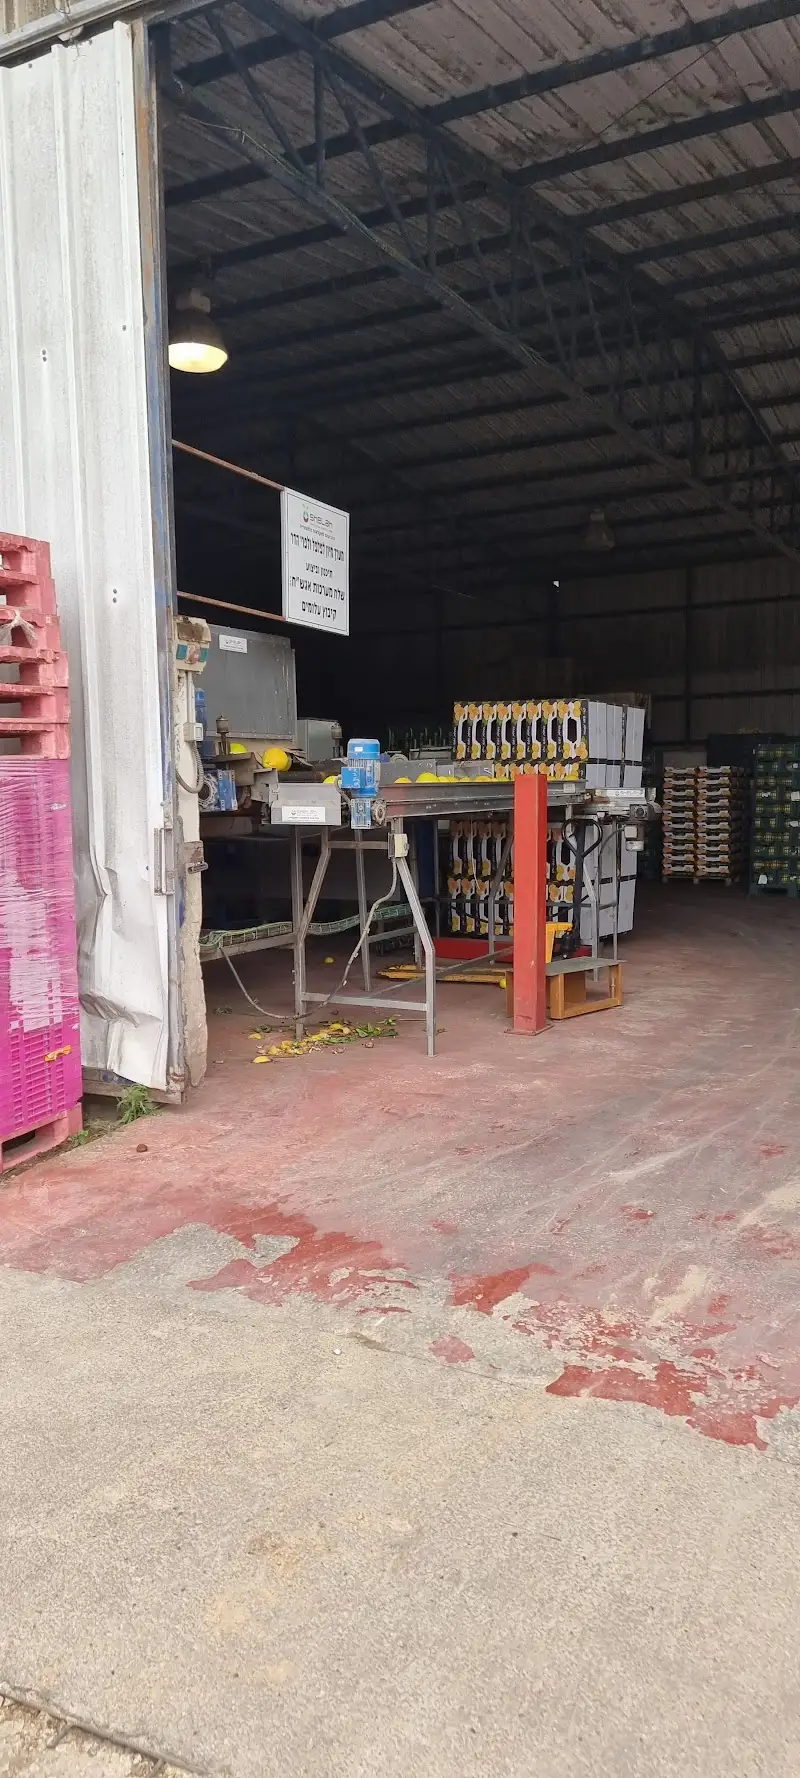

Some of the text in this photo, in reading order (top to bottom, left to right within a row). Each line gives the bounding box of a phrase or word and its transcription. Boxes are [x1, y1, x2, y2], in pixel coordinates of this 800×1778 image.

[312, 582, 333, 598] מערכות
[301, 600, 337, 622] קיבוץ עלומים
